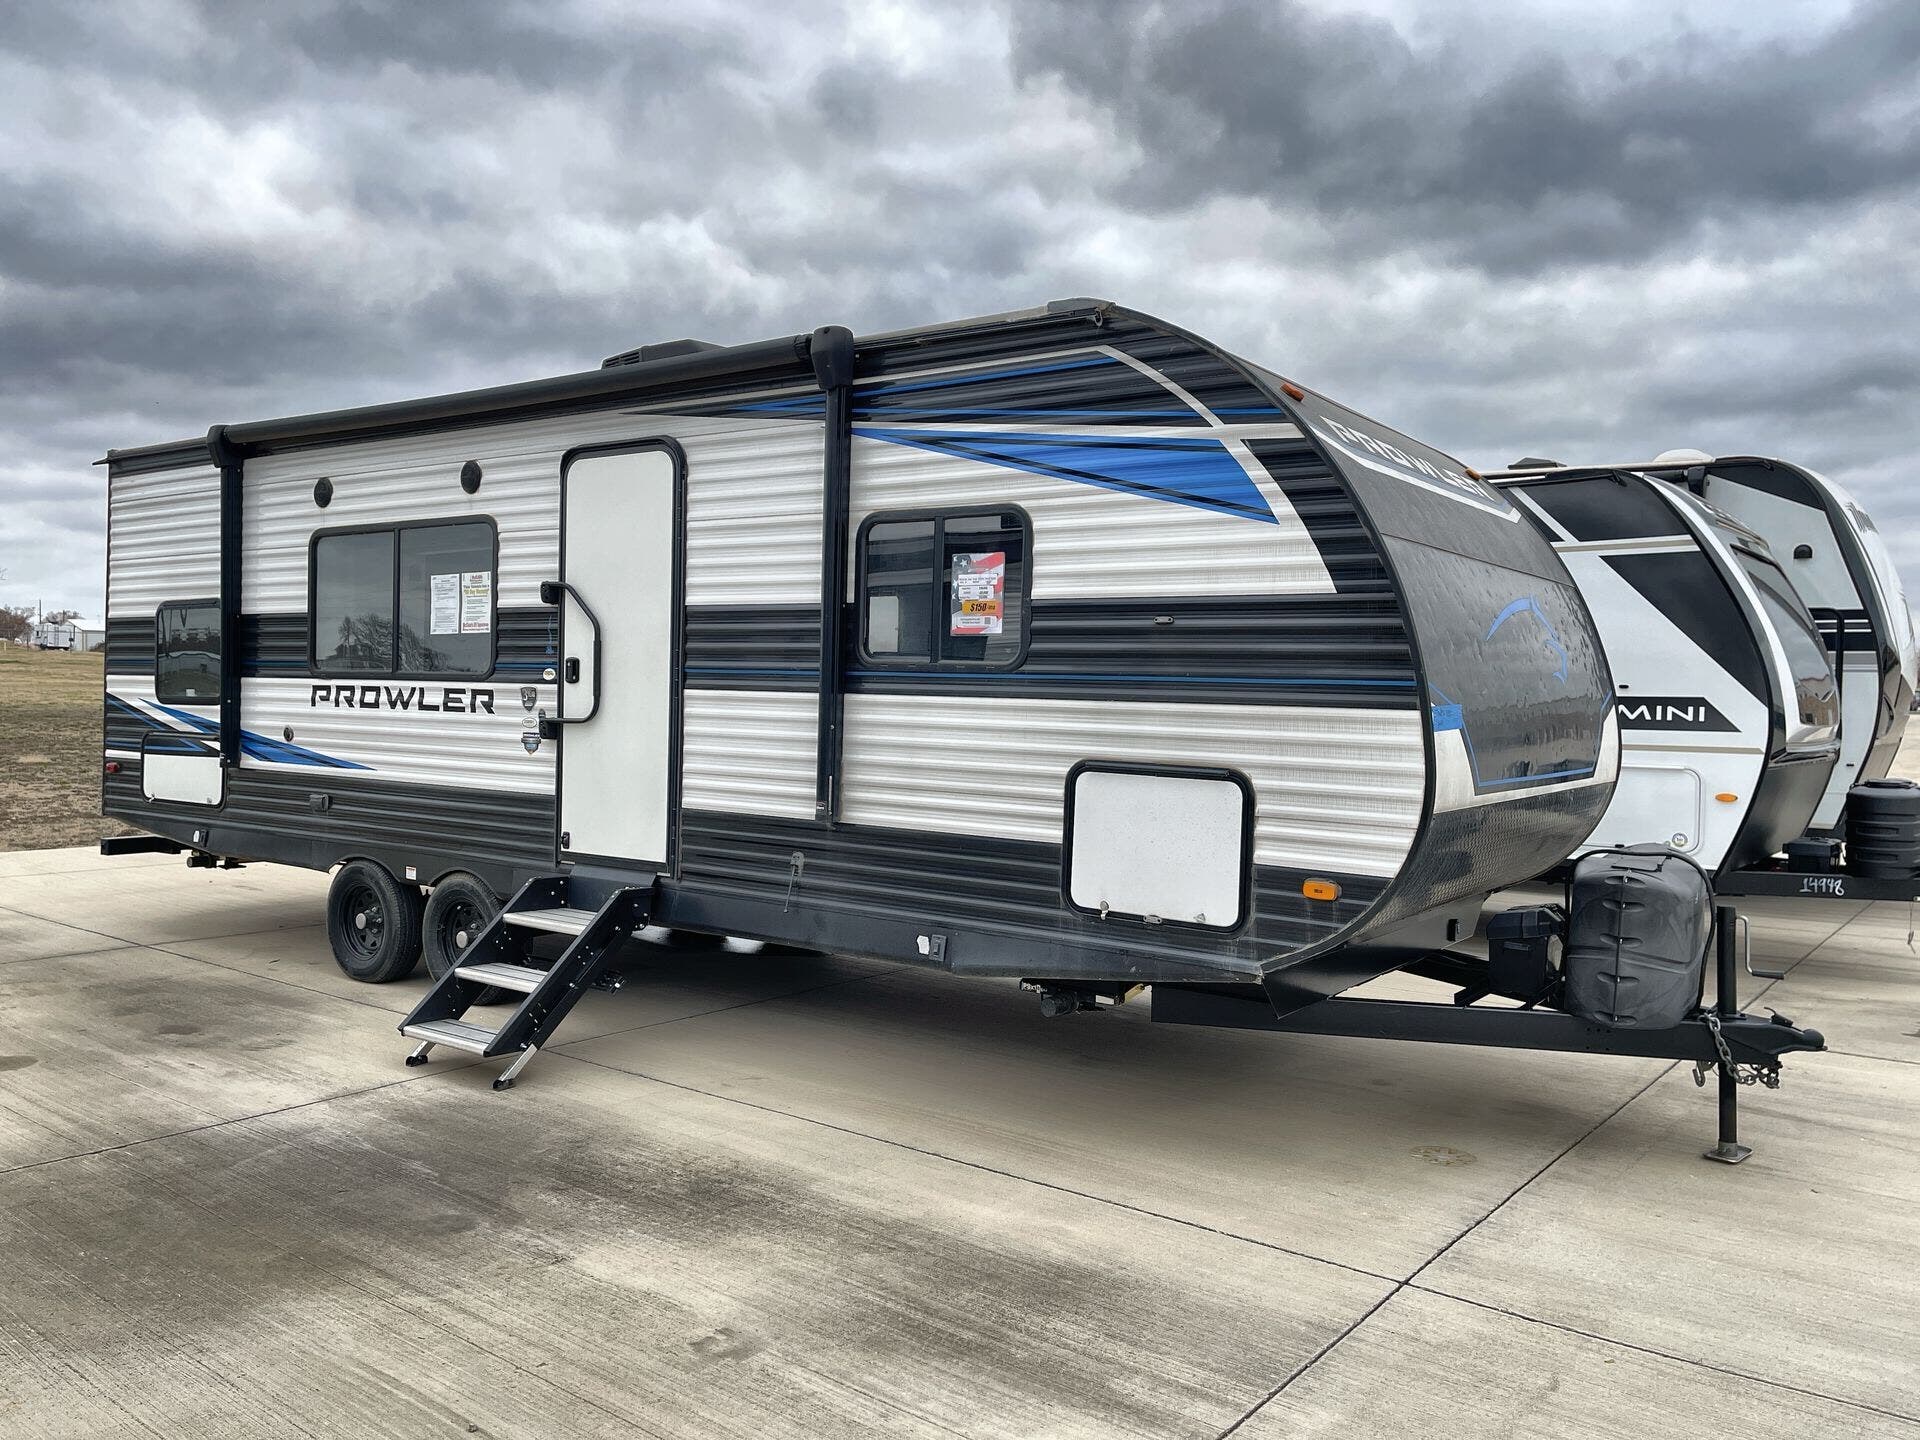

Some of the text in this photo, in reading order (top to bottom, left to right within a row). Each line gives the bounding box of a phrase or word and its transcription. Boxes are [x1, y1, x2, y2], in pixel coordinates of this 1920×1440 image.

[1320, 415, 1495, 502] PROWLER
[310, 684, 496, 715] PROWLER
[1618, 704, 1706, 722] MINI
[1799, 877, 1845, 897] 14948
